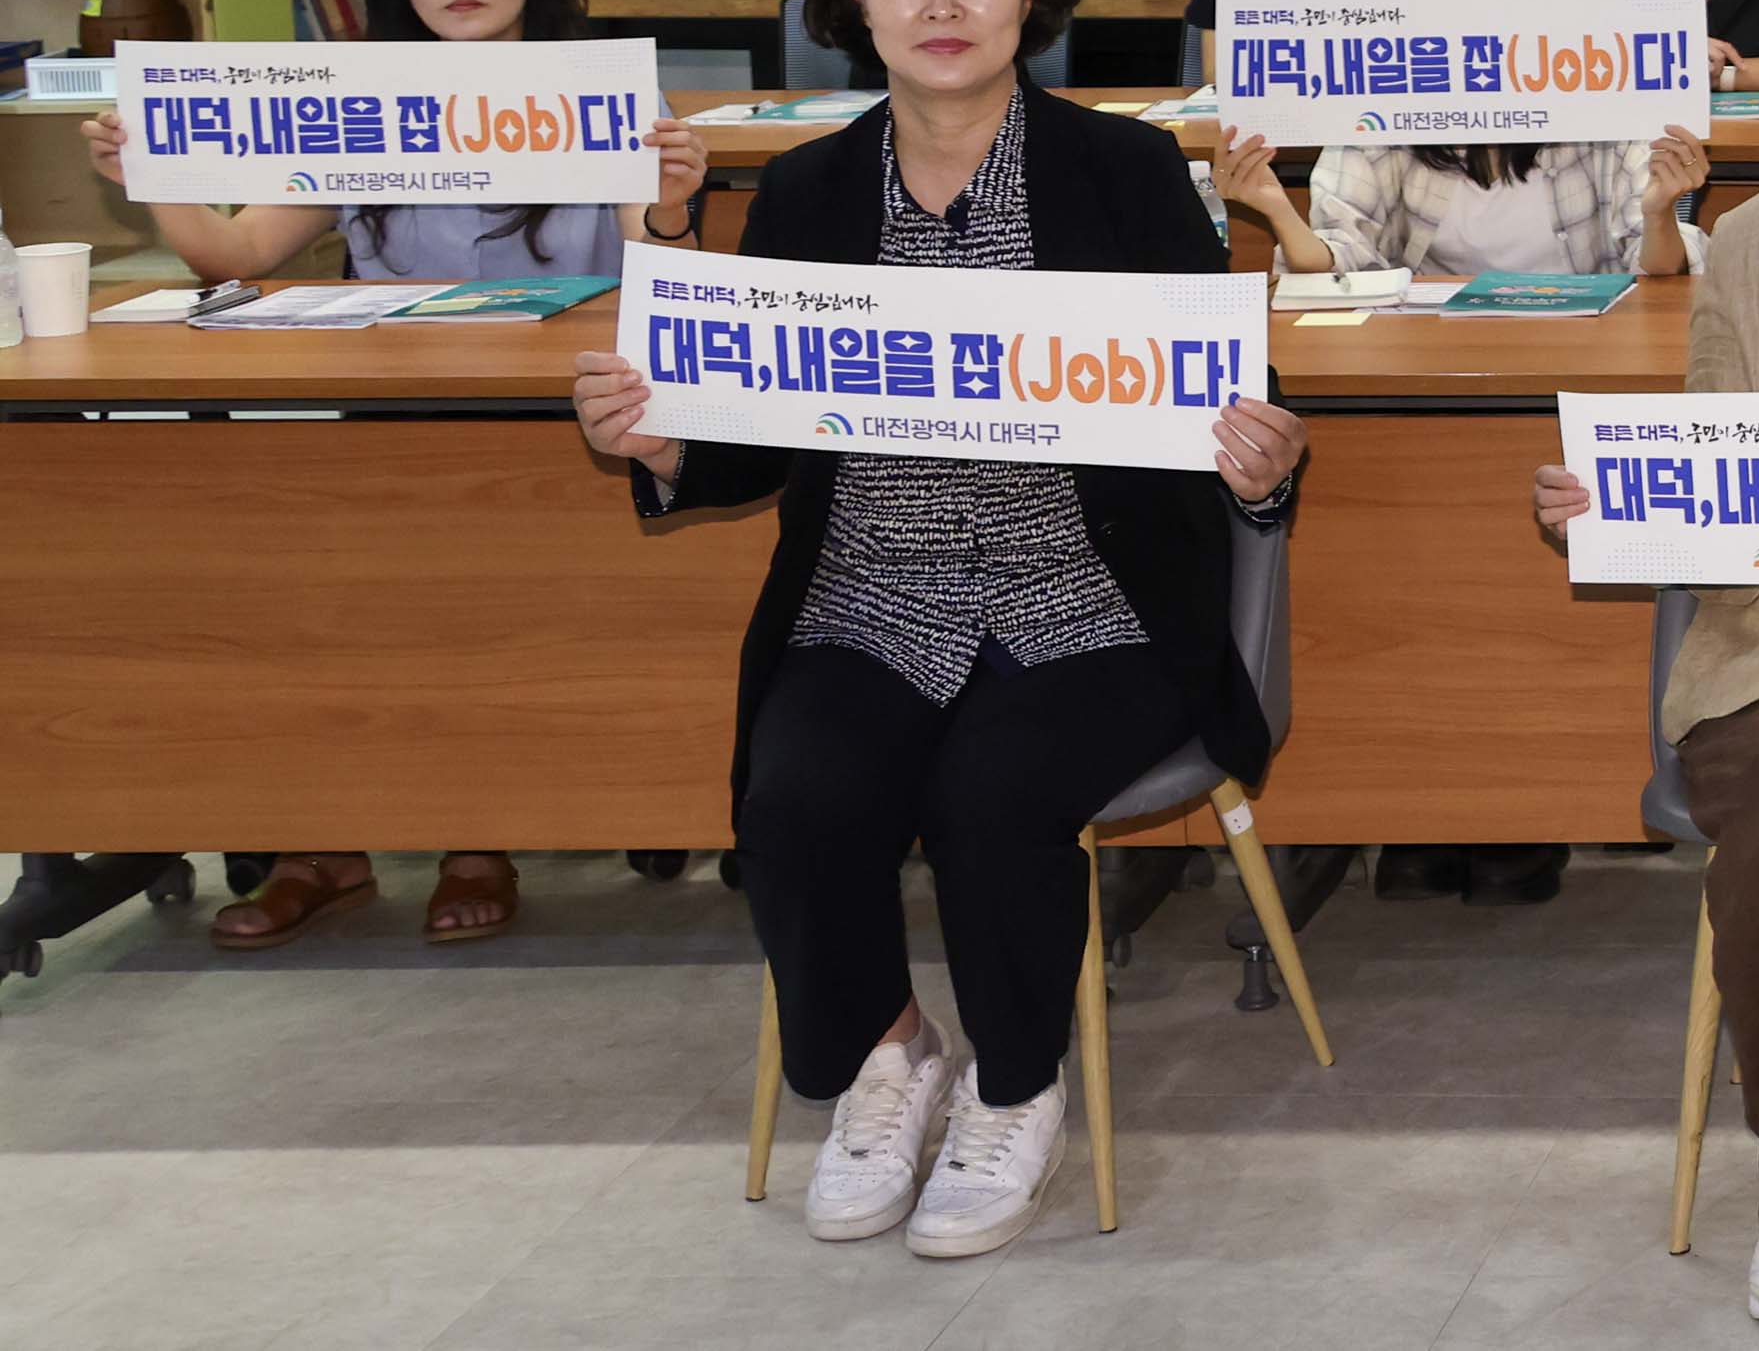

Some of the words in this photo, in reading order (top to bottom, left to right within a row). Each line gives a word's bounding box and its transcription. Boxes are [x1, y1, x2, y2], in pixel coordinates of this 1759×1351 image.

[1338, 8, 1405, 26] 중심입니다
[1462, 31, 1689, 92] 잡(Job)다!
[264, 67, 336, 84] 중심입니다
[396, 93, 643, 153] 잡(Job)다!
[1394, 112, 1487, 130] 대전광역시
[1494, 111, 1549, 128] 대덕구
[326, 173, 425, 191] 대전광역시
[432, 172, 490, 190] 대덕구
[792, 291, 878, 314] 중심입니다
[950, 333, 1244, 410] 잡(Job)다!
[863, 417, 981, 442] 대전광역시
[990, 423, 1060, 445] 대덕구
